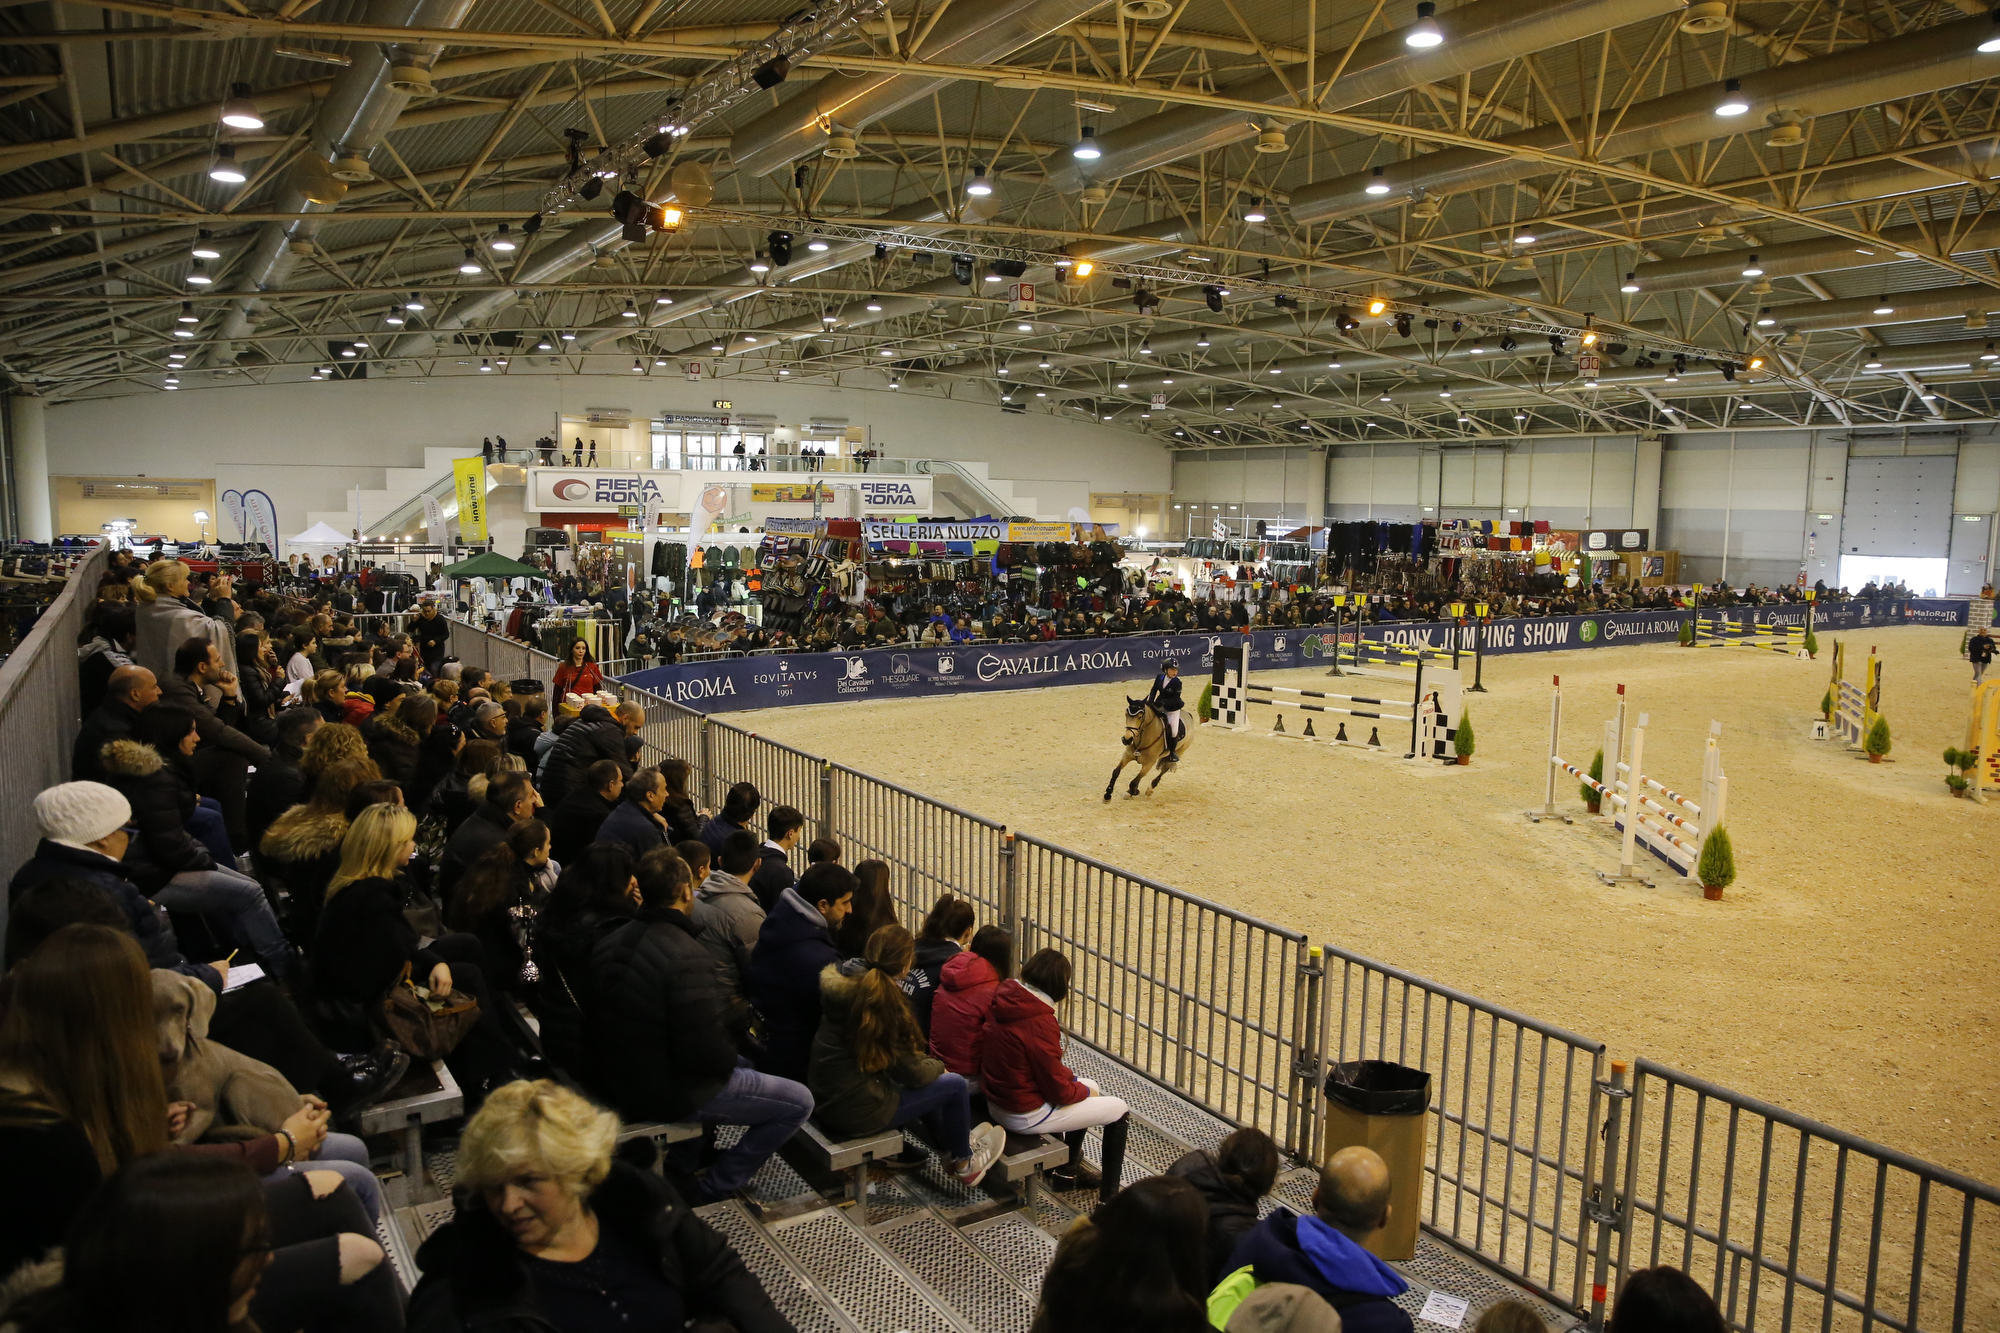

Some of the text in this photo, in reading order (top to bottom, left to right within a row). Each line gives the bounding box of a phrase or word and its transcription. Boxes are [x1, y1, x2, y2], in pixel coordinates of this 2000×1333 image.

[595, 478, 659, 491] FIERA
[595, 491, 664, 503] ROMA
[871, 524, 1000, 540] SELLERIA NUZZO
[1604, 620, 1645, 640] CAVALLI
[1646, 621, 1653, 634] A
[1654, 620, 1679, 634] ROMA
[1383, 628, 1432, 655] PONY
[1523, 622, 1569, 646] SHOW
[1142, 648, 1191, 659] EQVITATVS
[977, 651, 1132, 682] CAVALLI A ROMA
[754, 671, 817, 684] EQVITATVS
[676, 676, 737, 702] ROMA
[777, 689, 793, 697] 1991
